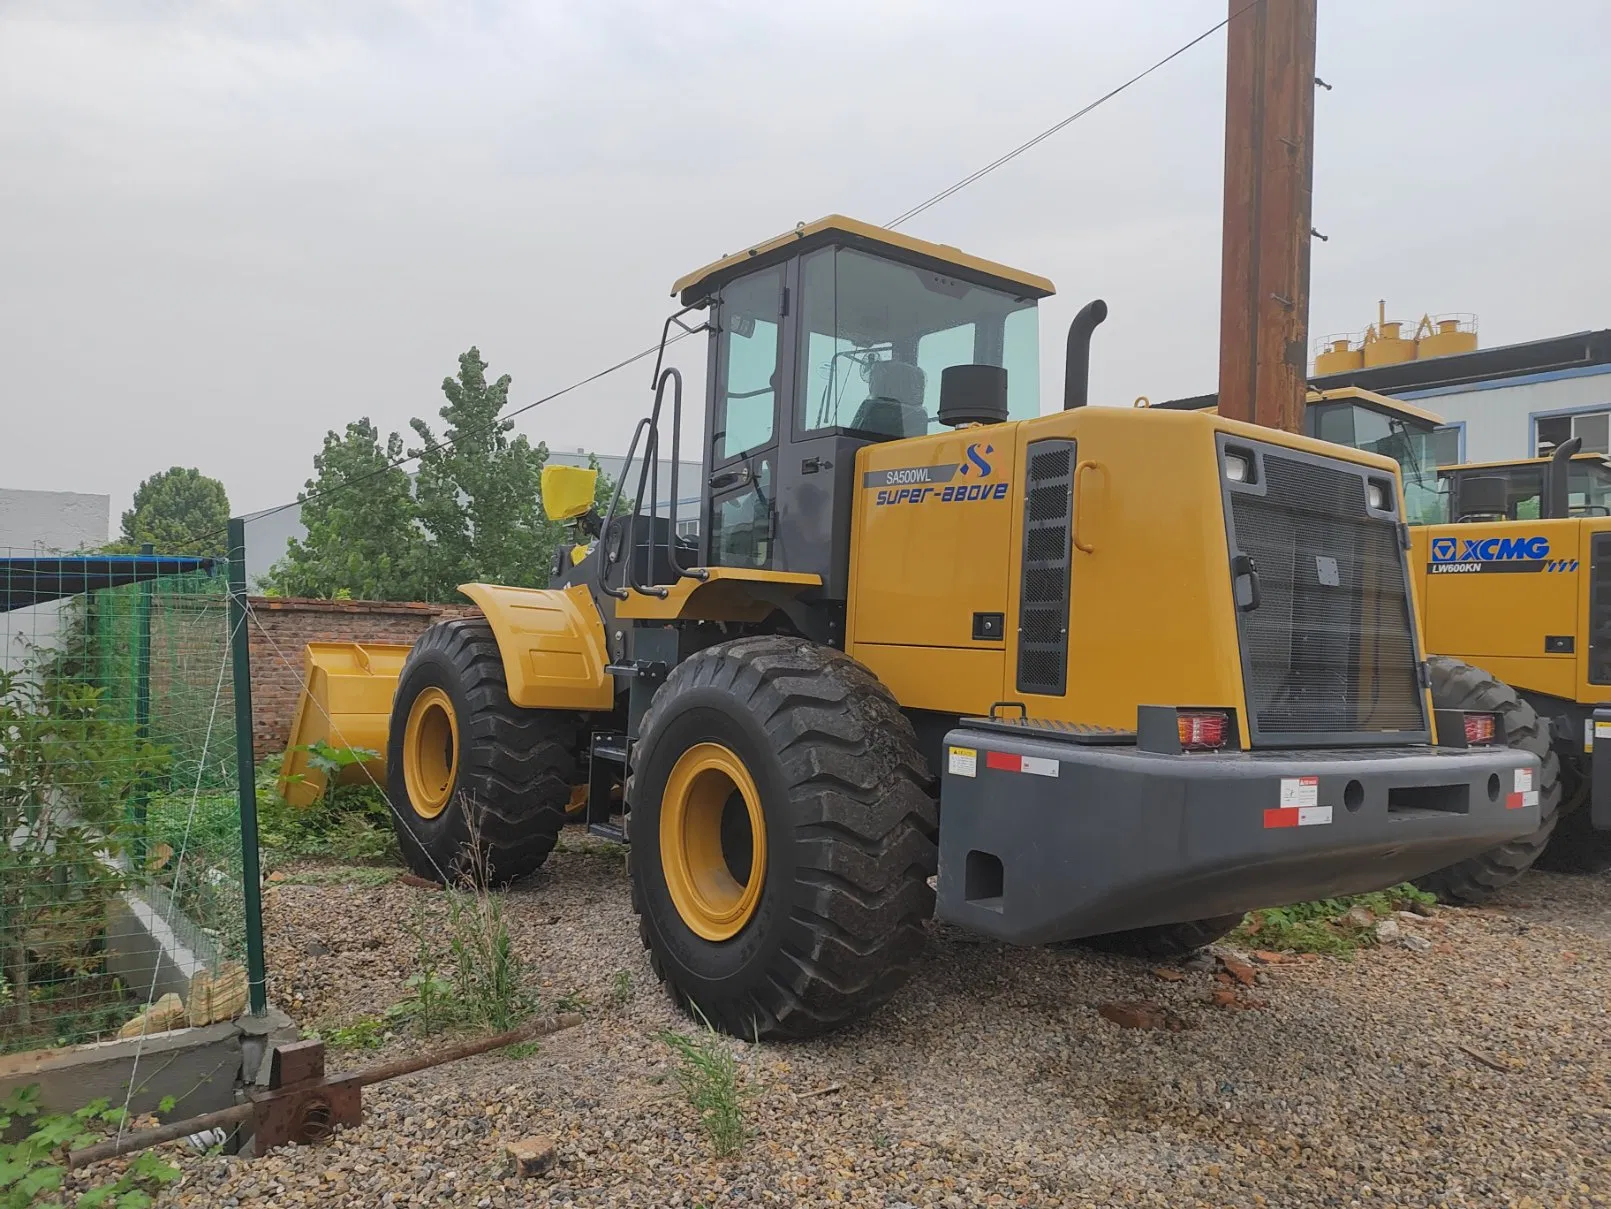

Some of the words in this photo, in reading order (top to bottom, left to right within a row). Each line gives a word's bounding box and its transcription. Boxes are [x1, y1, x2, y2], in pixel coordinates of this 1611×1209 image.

[886, 468, 932, 485] SA500WL
[1458, 536, 1550, 561] XCMG
[1432, 562, 1482, 574] LW600KN
